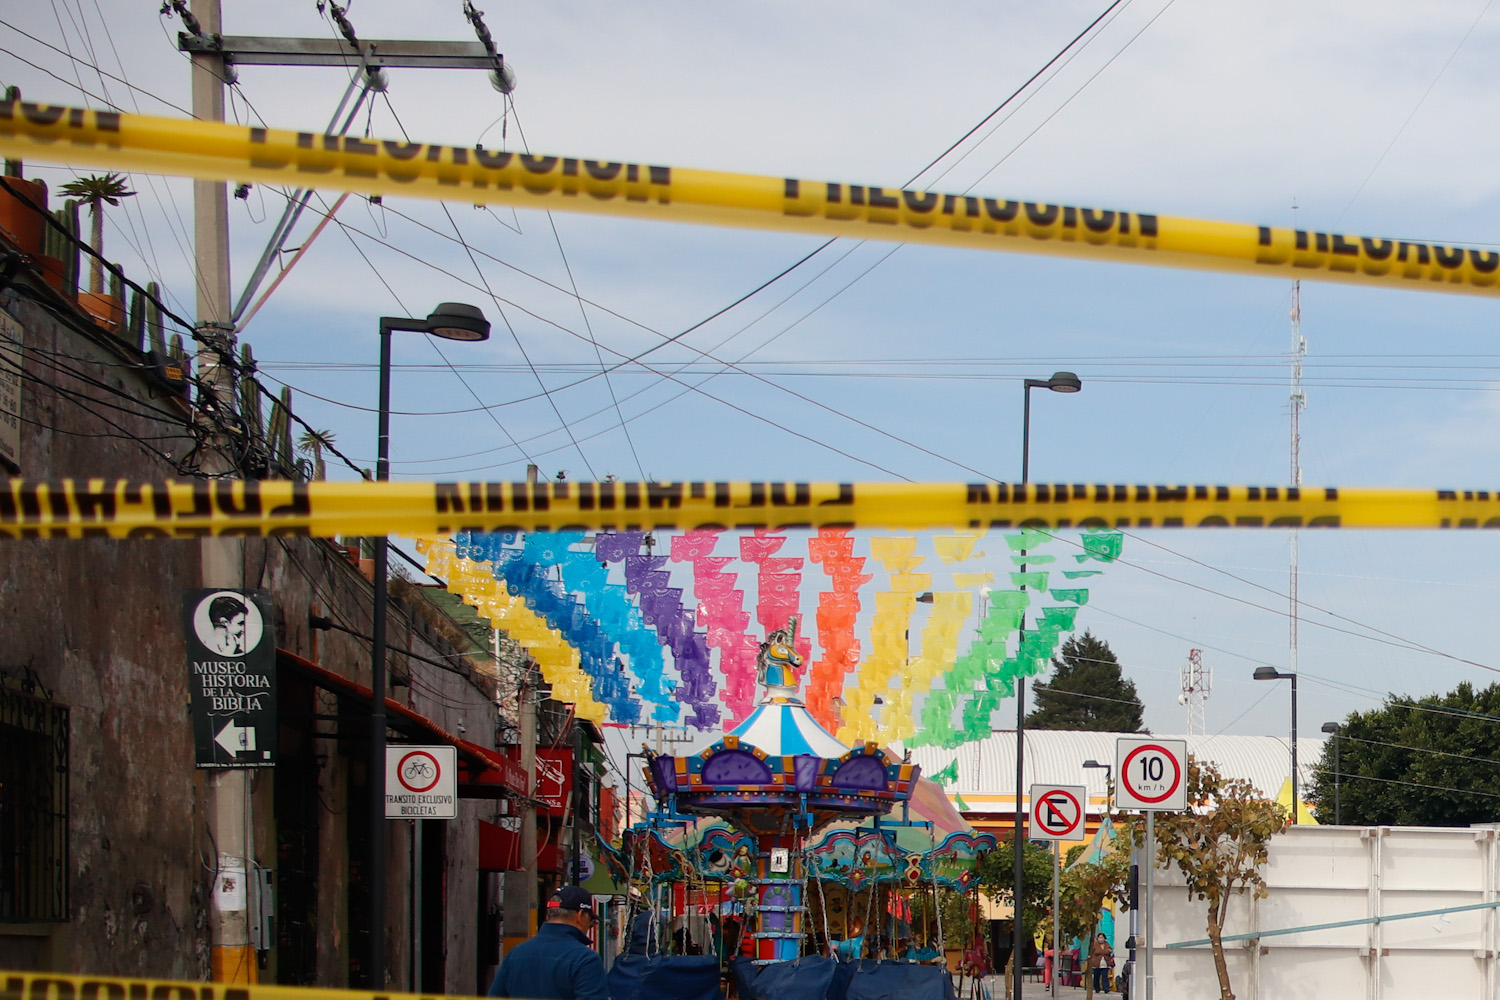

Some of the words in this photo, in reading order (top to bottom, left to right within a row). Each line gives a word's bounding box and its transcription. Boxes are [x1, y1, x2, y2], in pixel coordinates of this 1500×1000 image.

[193, 661, 247, 675] MUSEO
[201, 674, 271, 688] HISTORIA
[203, 687, 217, 697] DE
[220, 687, 235, 697] LA
[212, 697, 263, 711] BIBLIA
[1139, 756, 1164, 782] 10
[385, 794, 416, 804] TRANSITO
[418, 794, 453, 804] EXCLUSIVO
[401, 805, 437, 815] BICICLETAS
